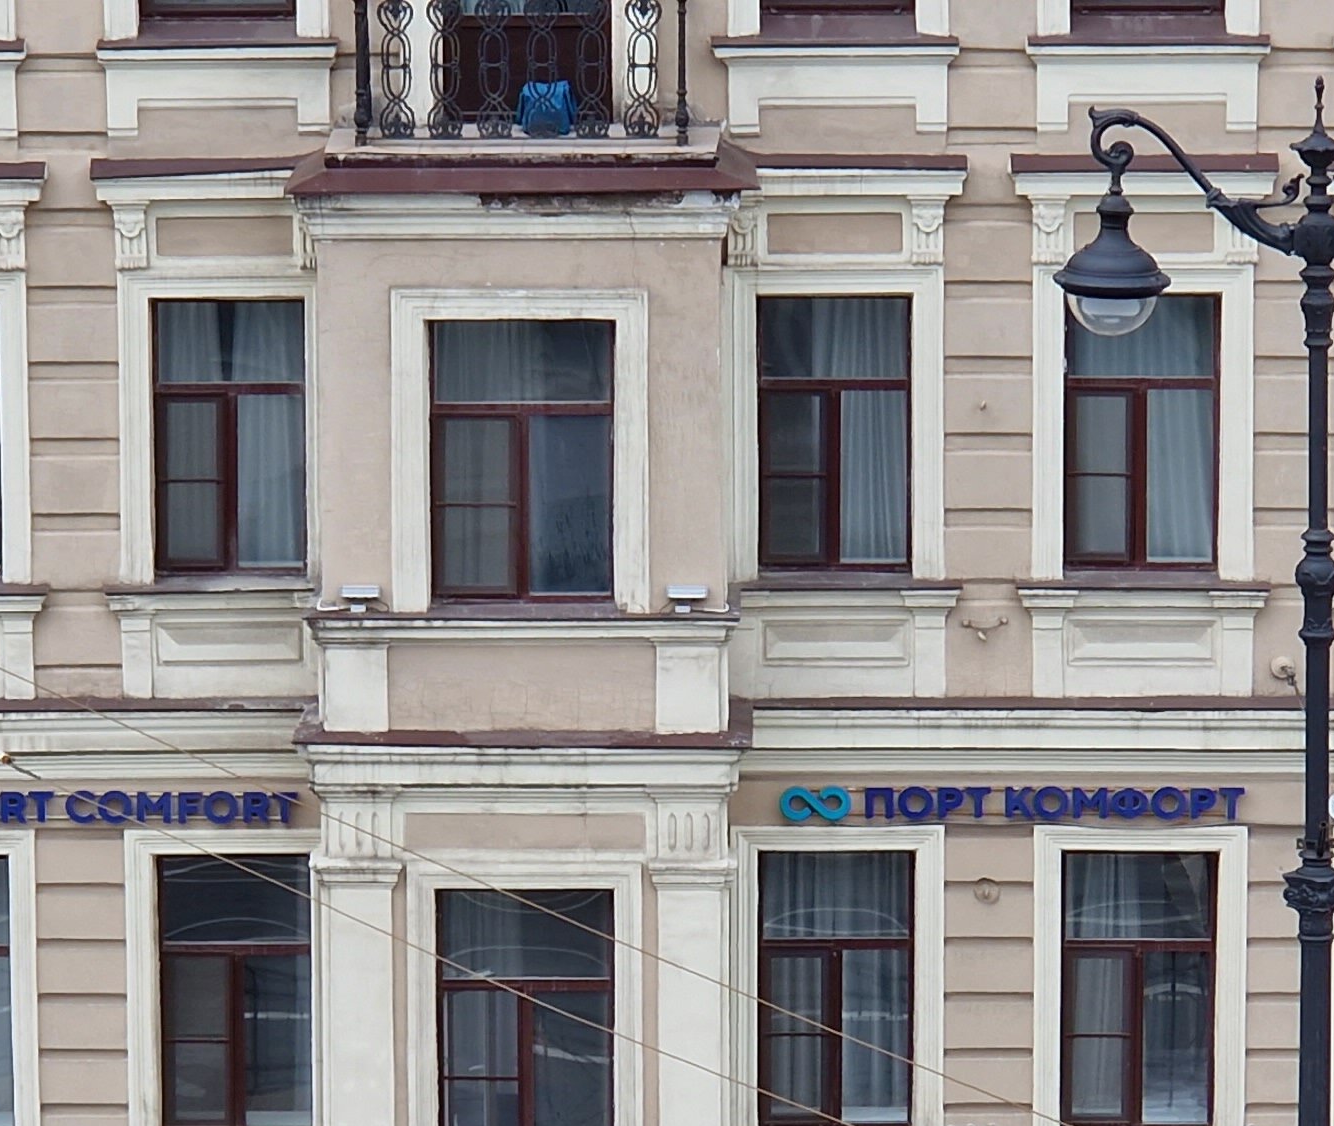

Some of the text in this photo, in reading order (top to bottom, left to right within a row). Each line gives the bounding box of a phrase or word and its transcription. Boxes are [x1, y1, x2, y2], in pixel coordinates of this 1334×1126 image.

[65, 790, 299, 825] COMFORT
[864, 786, 1246, 821] ПОРТ КОМФОРТ
